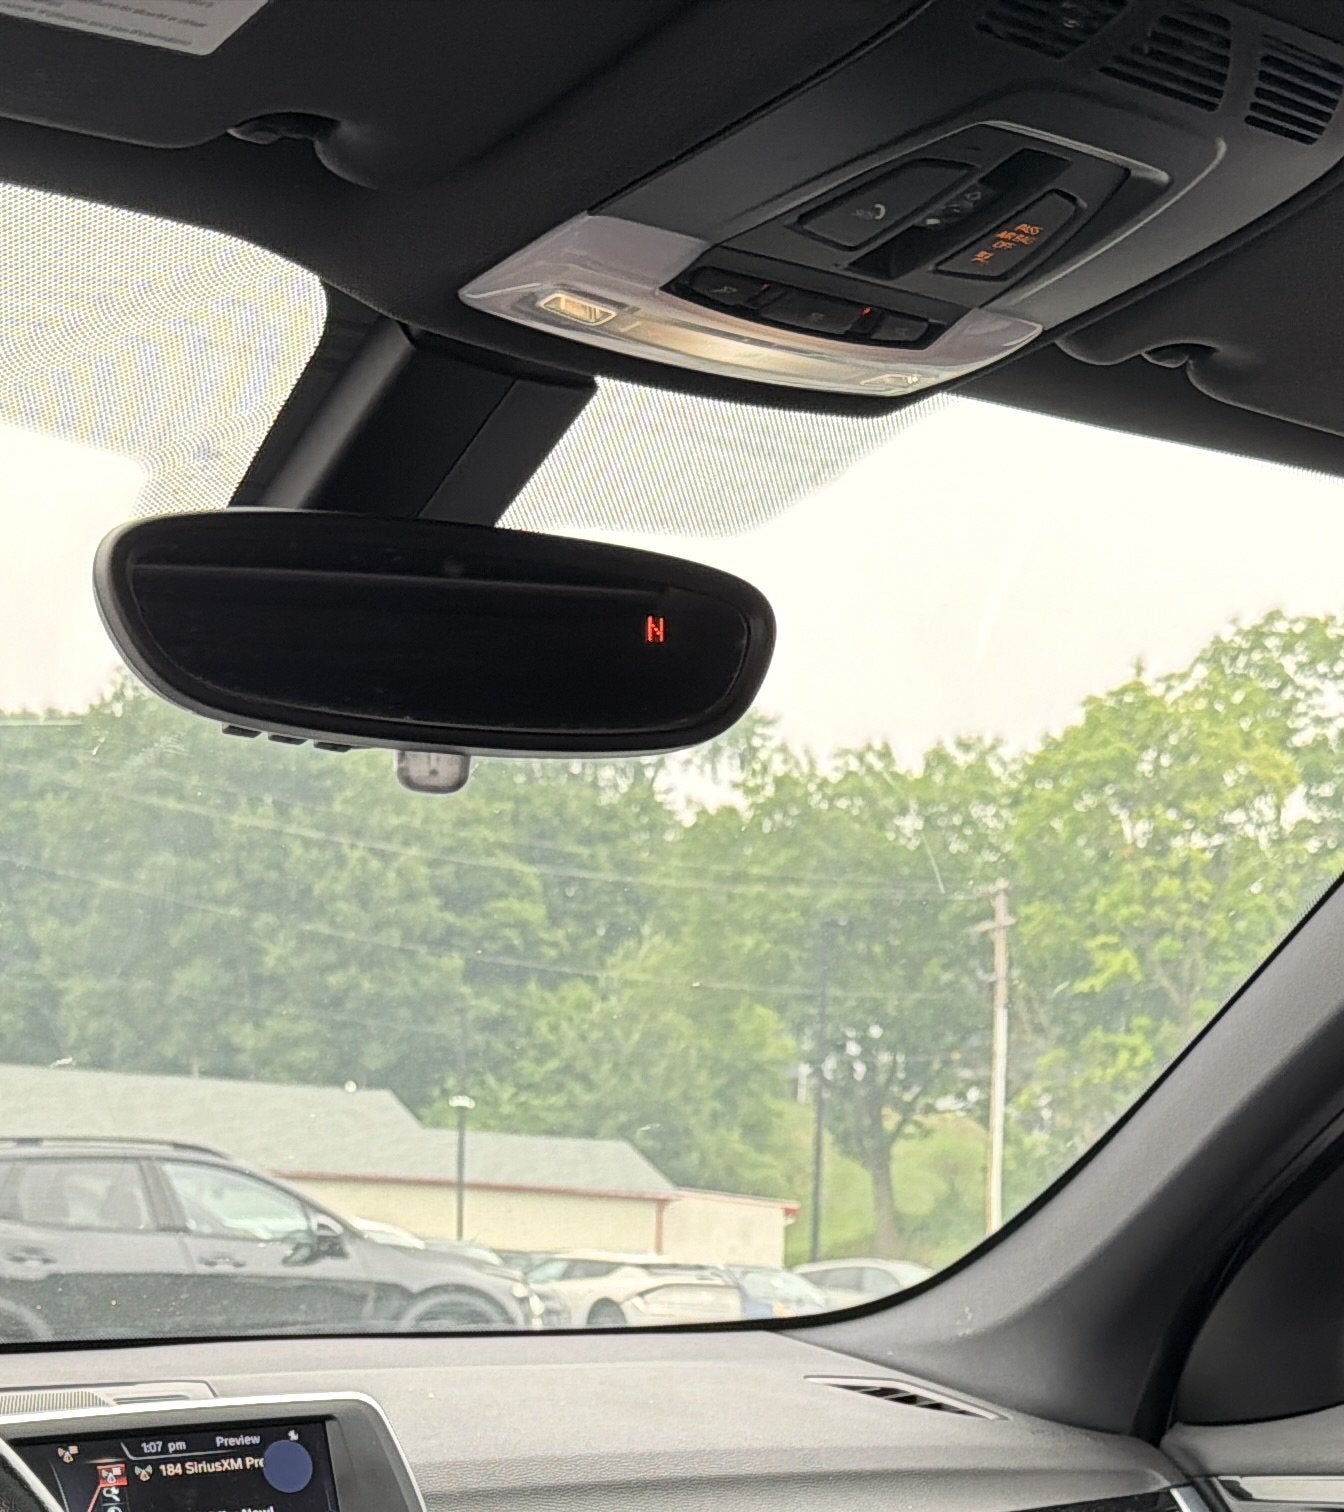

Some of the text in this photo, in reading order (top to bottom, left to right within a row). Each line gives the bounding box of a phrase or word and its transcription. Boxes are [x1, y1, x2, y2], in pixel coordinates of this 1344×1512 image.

[647, 615, 665, 642] N
[141, 1441, 187, 1454] 1:07 pm
[216, 1434, 261, 1447] Preview
[159, 1463, 183, 1477] 184
[185, 1457, 244, 1475] SiriusXM
